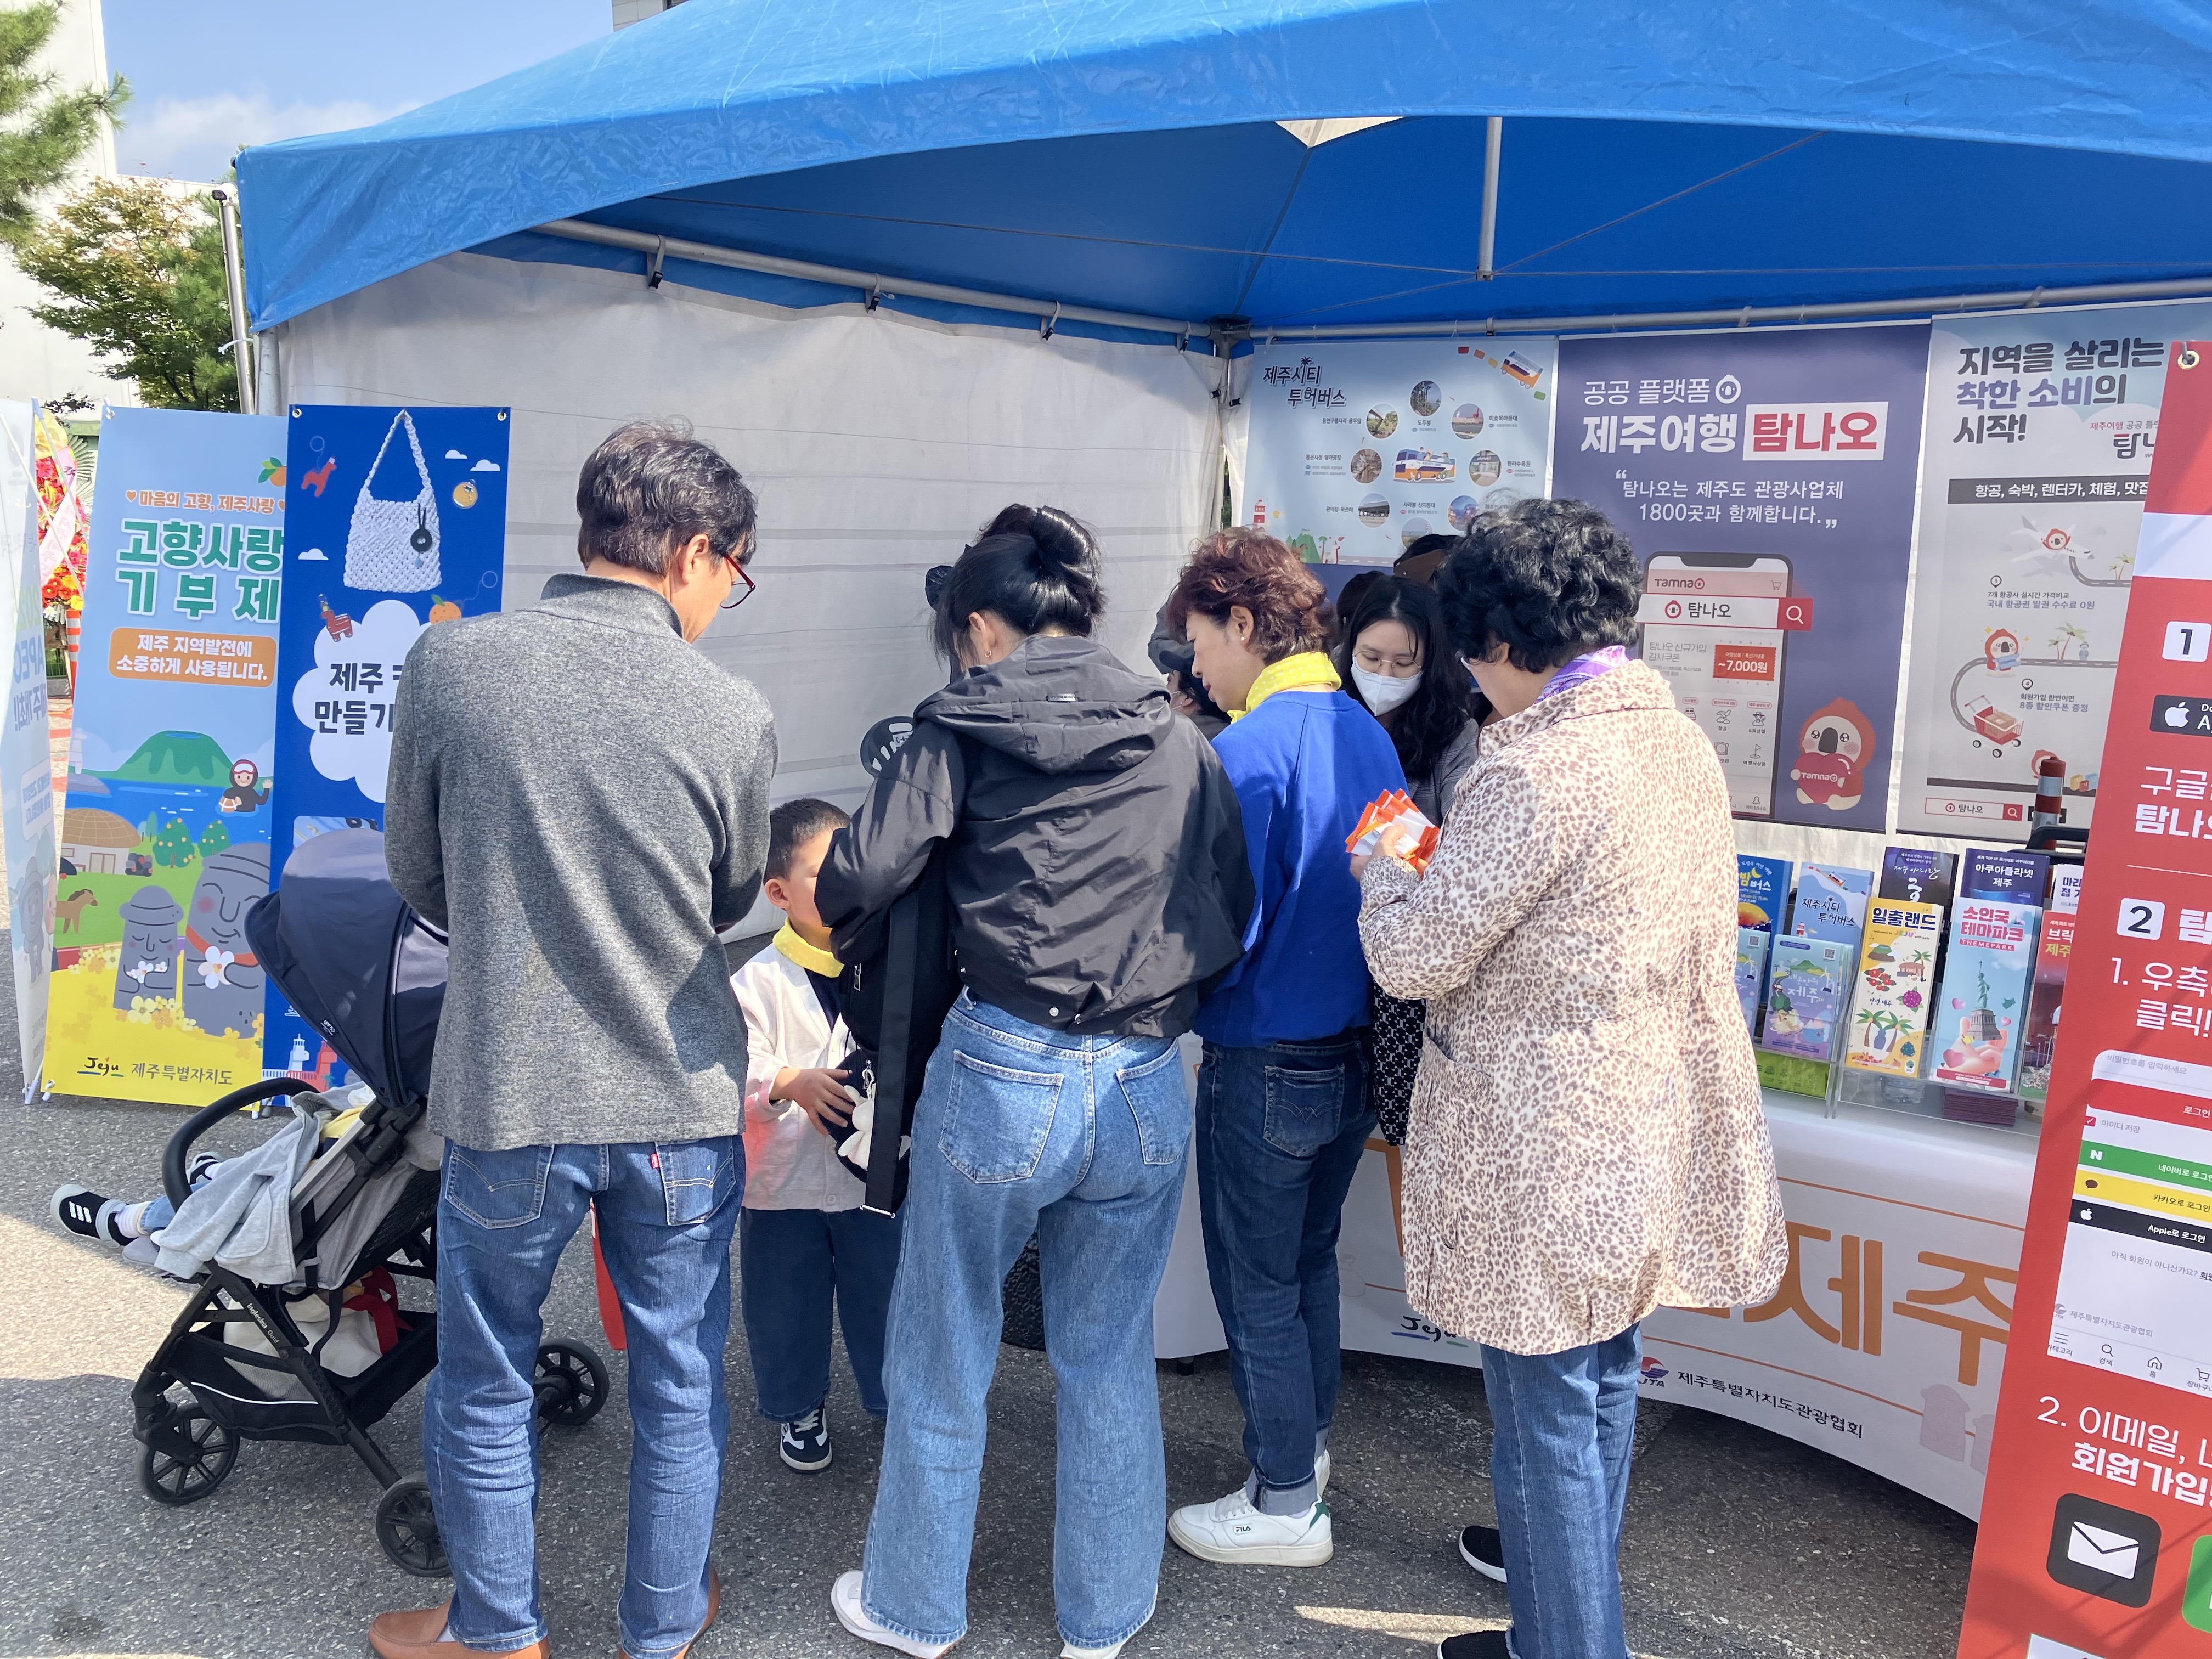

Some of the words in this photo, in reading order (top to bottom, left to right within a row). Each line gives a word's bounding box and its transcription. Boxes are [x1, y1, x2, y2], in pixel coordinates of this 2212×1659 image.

[1957, 342, 2053, 375] 지역을
[2065, 337, 2164, 370] 살리는
[1263, 362, 1321, 385] 제주시티
[1584, 380, 1630, 405] 공공
[1638, 377, 1711, 405] 플랫폼
[1956, 379, 2021, 410] 착한
[2027, 374, 2126, 407] 소비의
[1581, 414, 1738, 454] 제주여행
[1753, 411, 1877, 452] 탐나오
[1953, 414, 2027, 444] 시작!
[2090, 421, 2123, 430] 제주여행
[2126, 421, 2142, 430] 공공
[1696, 481, 1746, 498] 제주도
[1754, 480, 1843, 499] 관광사업체
[1975, 484, 2005, 499] 항공,
[2008, 484, 2038, 498] 숙박,
[2041, 483, 2085, 497] 렌터카,
[2089, 482, 2120, 496] 체험,
[139, 490, 179, 507] 마음의
[183, 493, 215, 512] 고향,
[218, 495, 275, 514] 제주사랑
[1639, 503, 1721, 523] 1800곳과
[117, 519, 284, 573] 고향사랑
[1688, 602, 1731, 618] 탐나오
[1987, 600, 2002, 608] 국내
[2006, 600, 2029, 608] 항공권
[2033, 600, 2049, 608] 발권
[137, 634, 169, 652] 제주
[173, 636, 252, 658] 지역발전에
[1650, 642, 1673, 650] 탐나오
[1675, 643, 1707, 653] 신규가입
[2181, 629, 2194, 656] 1
[116, 654, 180, 675] 소중하게
[185, 659, 267, 680] 사용됩니다.
[1649, 653, 1680, 662] 감사쿠폰
[329, 663, 383, 694] 제주
[2019, 702, 2033, 710] 8종
[2036, 702, 2068, 712] 할인쿠폰
[2072, 703, 2089, 712] 증정
[315, 701, 394, 735] 만들기
[2141, 766, 2212, 801] 구글
[1959, 804, 1983, 814] 탐나오
[1976, 864, 2034, 878] 아쿠아플라넷
[1993, 878, 2012, 888] 제주
[1802, 898, 1840, 912] 제주시티
[1963, 906, 2010, 924] 소인국
[1872, 908, 1936, 930] 일출랜드
[2128, 906, 2152, 934] 2
[1961, 922, 2024, 942] 테마파크
[2047, 928, 2074, 943] 브릭
[1962, 939, 2012, 951] THEMEPARK
[2045, 943, 2071, 957] 제주
[2112, 957, 2128, 986] 1.
[2142, 962, 2212, 998] 우측
[2136, 999, 2212, 1037] 클릭!
[84, 1057, 119, 1076] Jeju
[131, 1063, 233, 1085] 제주특별자치도
[2107, 1055, 2145, 1067] 비밀번호를
[2148, 1062, 2186, 1074] 입력하세요
[2183, 1106, 2211, 1118] 로그인
[2101, 1120, 2123, 1130] 아이디
[2125, 1125, 2140, 1133] 저장
[2158, 1164, 2189, 1176] 네이버로
[2153, 1194, 2184, 1207] 카카오로
[2186, 1201, 2210, 1213] 로그인
[2148, 1224, 2179, 1238] Apple로
[2181, 1232, 2205, 1244] 로그인
[2111, 1251, 2126, 1261] 아직
[2129, 1255, 2152, 1266] 회원이
[2154, 1261, 2198, 1277] 아니신가요?
[2070, 1310, 2153, 1338] 제주특별자치도관광협회
[2099, 1357, 2113, 1366] 검색
[1678, 1371, 1863, 1438] 제주특별자치도관광협회
[2037, 1396, 2067, 1427] 2.
[2079, 1406, 2185, 1465] 이메일,
[2072, 1442, 2212, 1509] 회원가입
